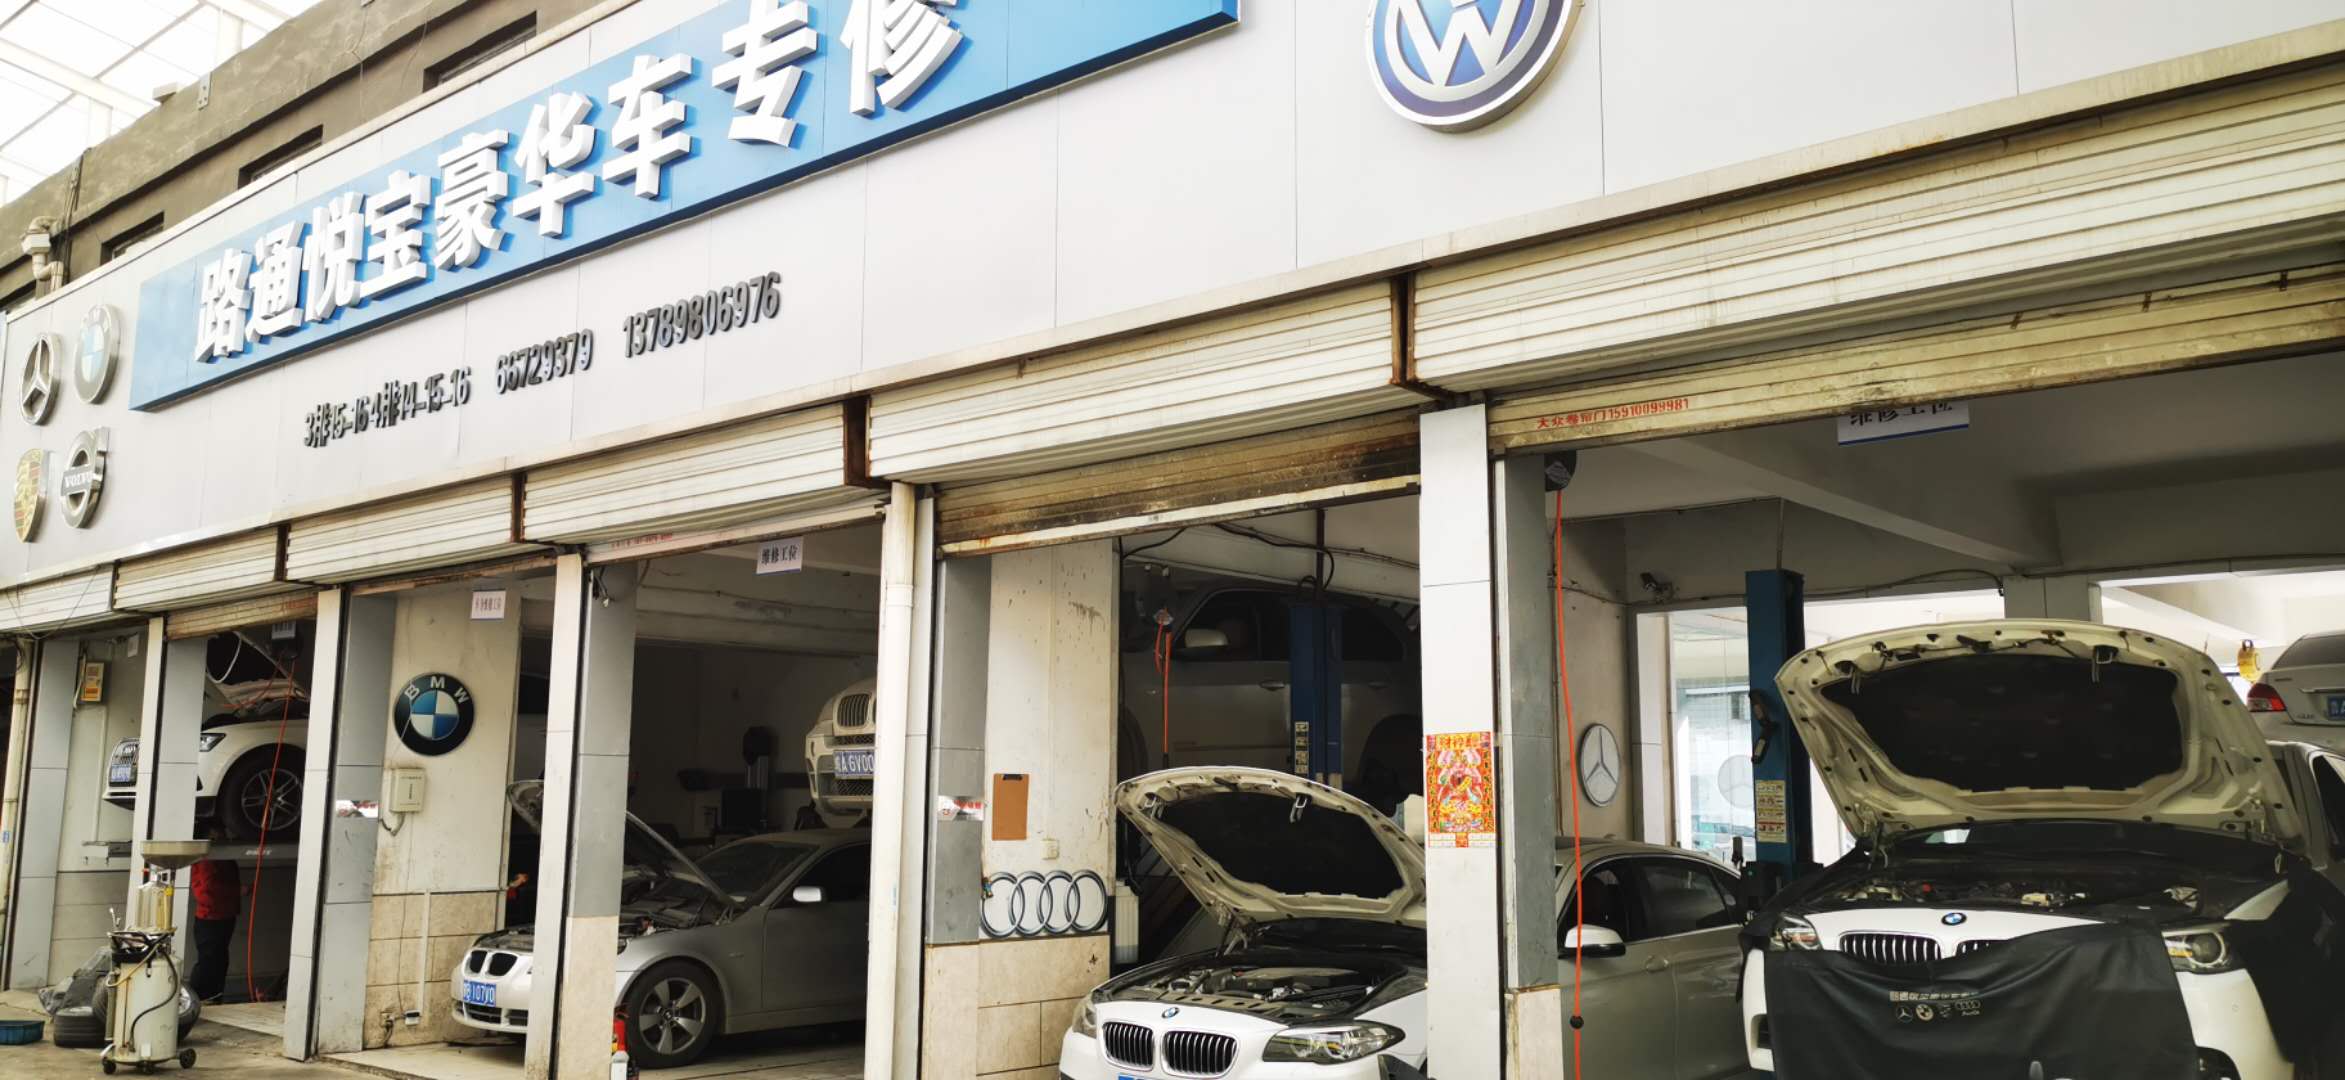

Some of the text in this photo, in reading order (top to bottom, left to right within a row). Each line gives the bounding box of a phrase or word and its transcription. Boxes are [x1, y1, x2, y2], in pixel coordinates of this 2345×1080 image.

[196, 0, 963, 363] 路通悦宝豪华车专修
[495, 328, 594, 394] 66729379
[623, 271, 781, 358] 13789806976
[404, 676, 469, 704] BMW
